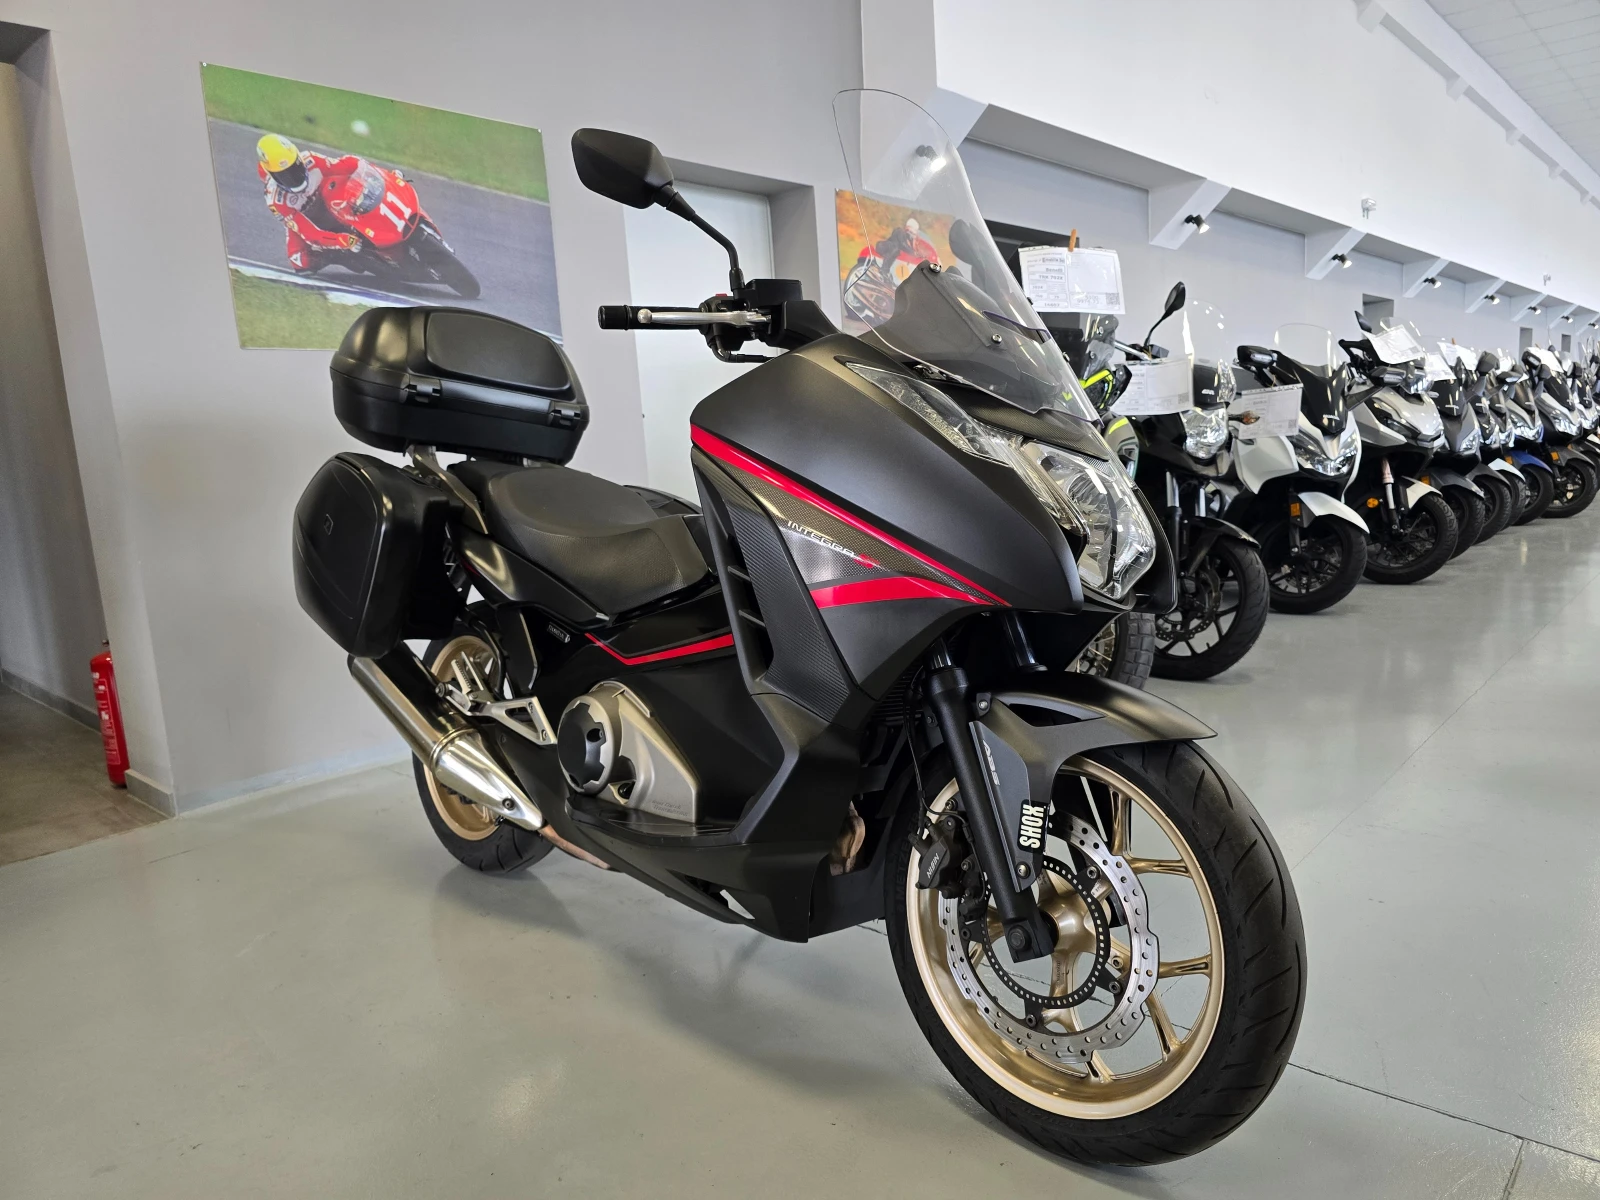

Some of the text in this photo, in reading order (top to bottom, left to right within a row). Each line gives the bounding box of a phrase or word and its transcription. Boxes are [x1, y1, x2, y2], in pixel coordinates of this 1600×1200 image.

[379, 192, 413, 233] 11
[787, 520, 855, 558] INTEGRA
[982, 740, 1001, 786] ABS
[1019, 803, 1045, 849] SHOX
[895, 812, 919, 901] METZEER
